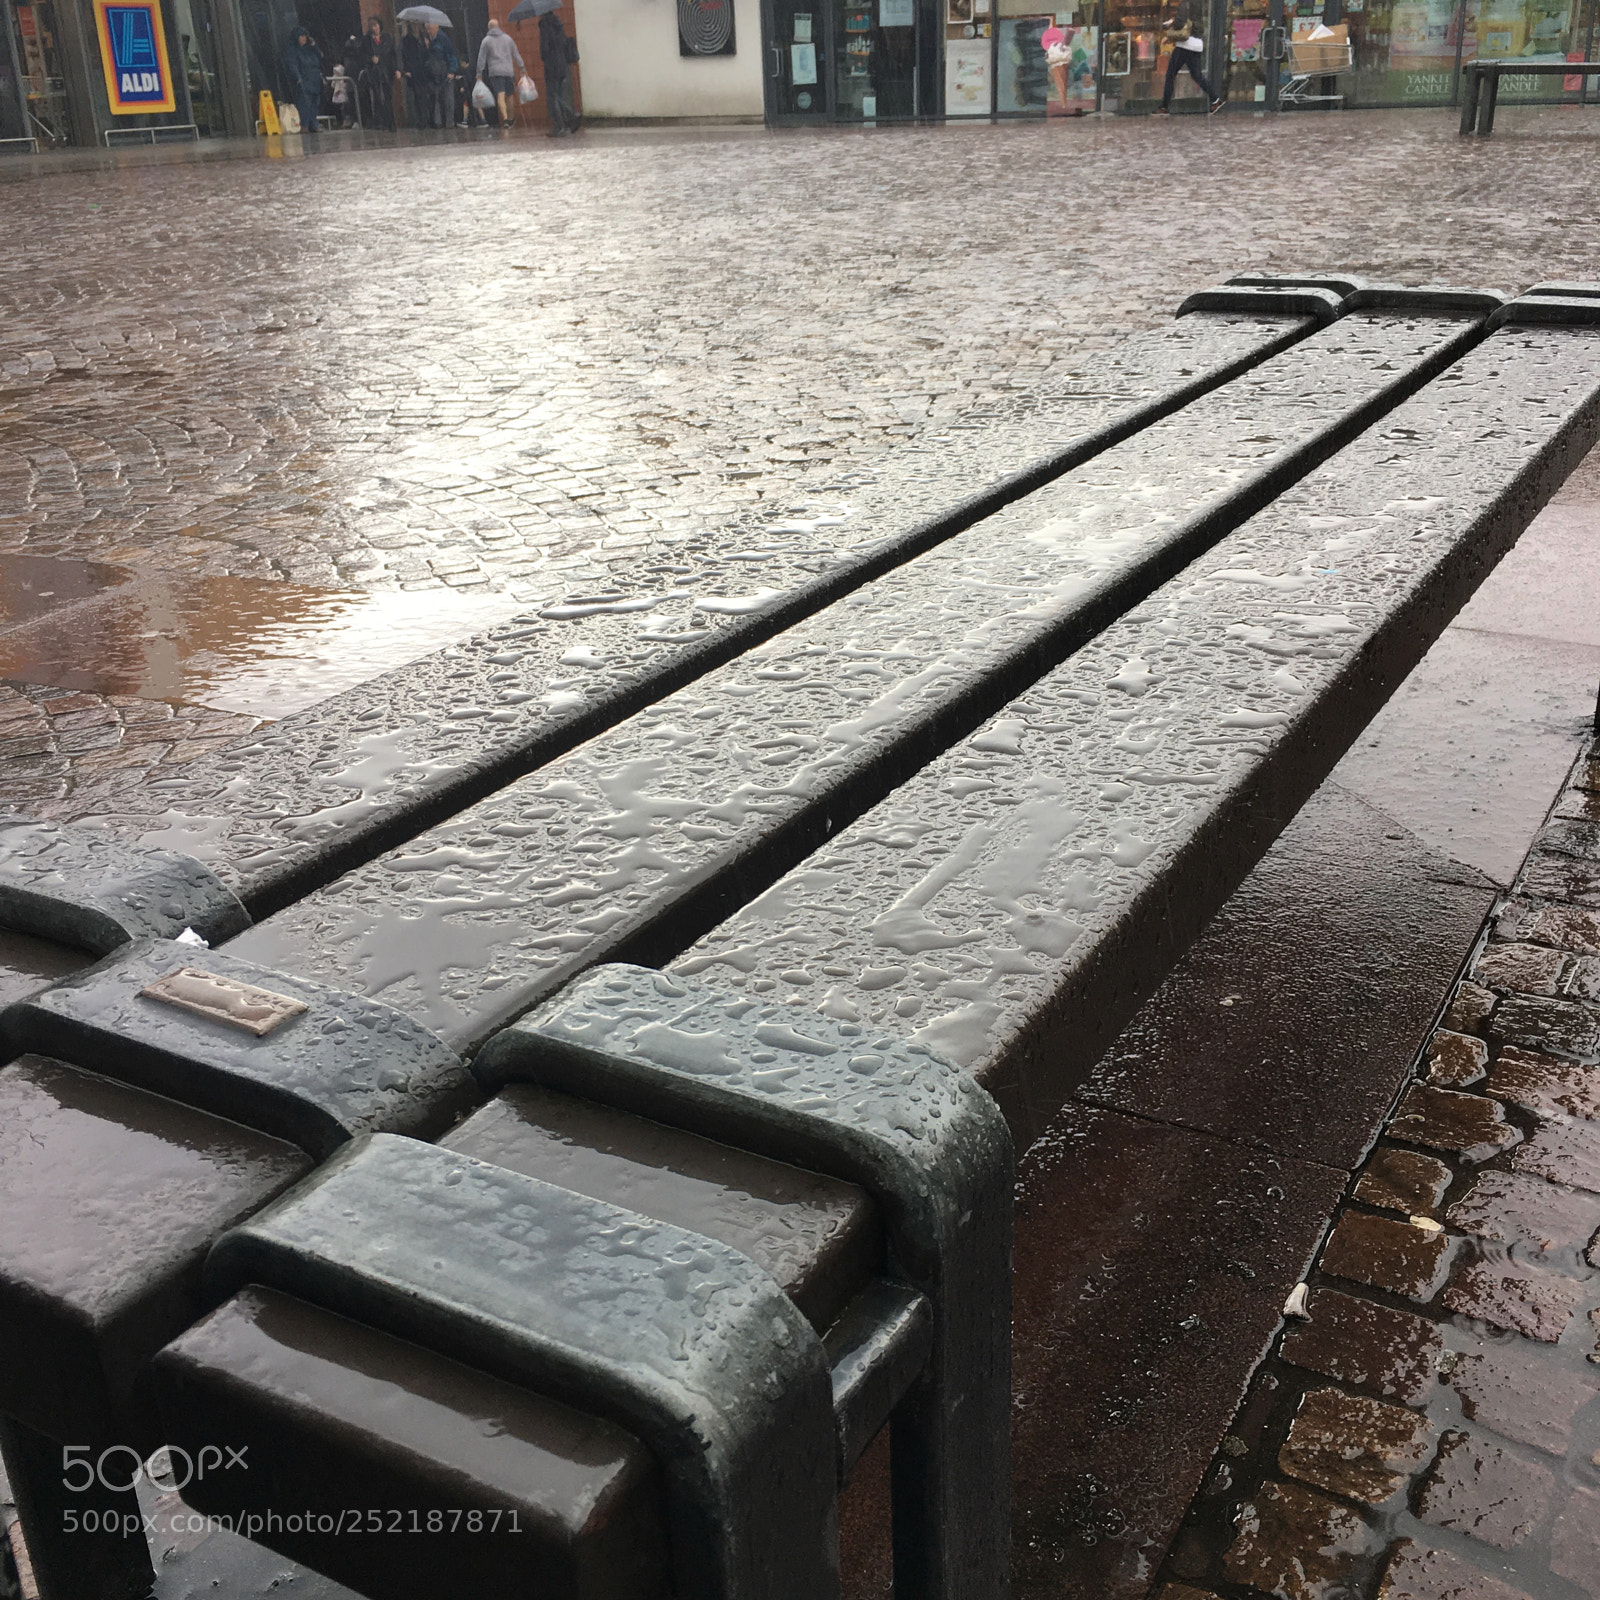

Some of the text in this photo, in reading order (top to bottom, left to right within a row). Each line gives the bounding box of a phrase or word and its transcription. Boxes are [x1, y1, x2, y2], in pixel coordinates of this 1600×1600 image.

[121, 73, 160, 93] ALDI
[1406, 73, 1452, 84] YANKEE
[1405, 84, 1451, 95] CANDLE
[1498, 81, 1541, 92] ANDLE
